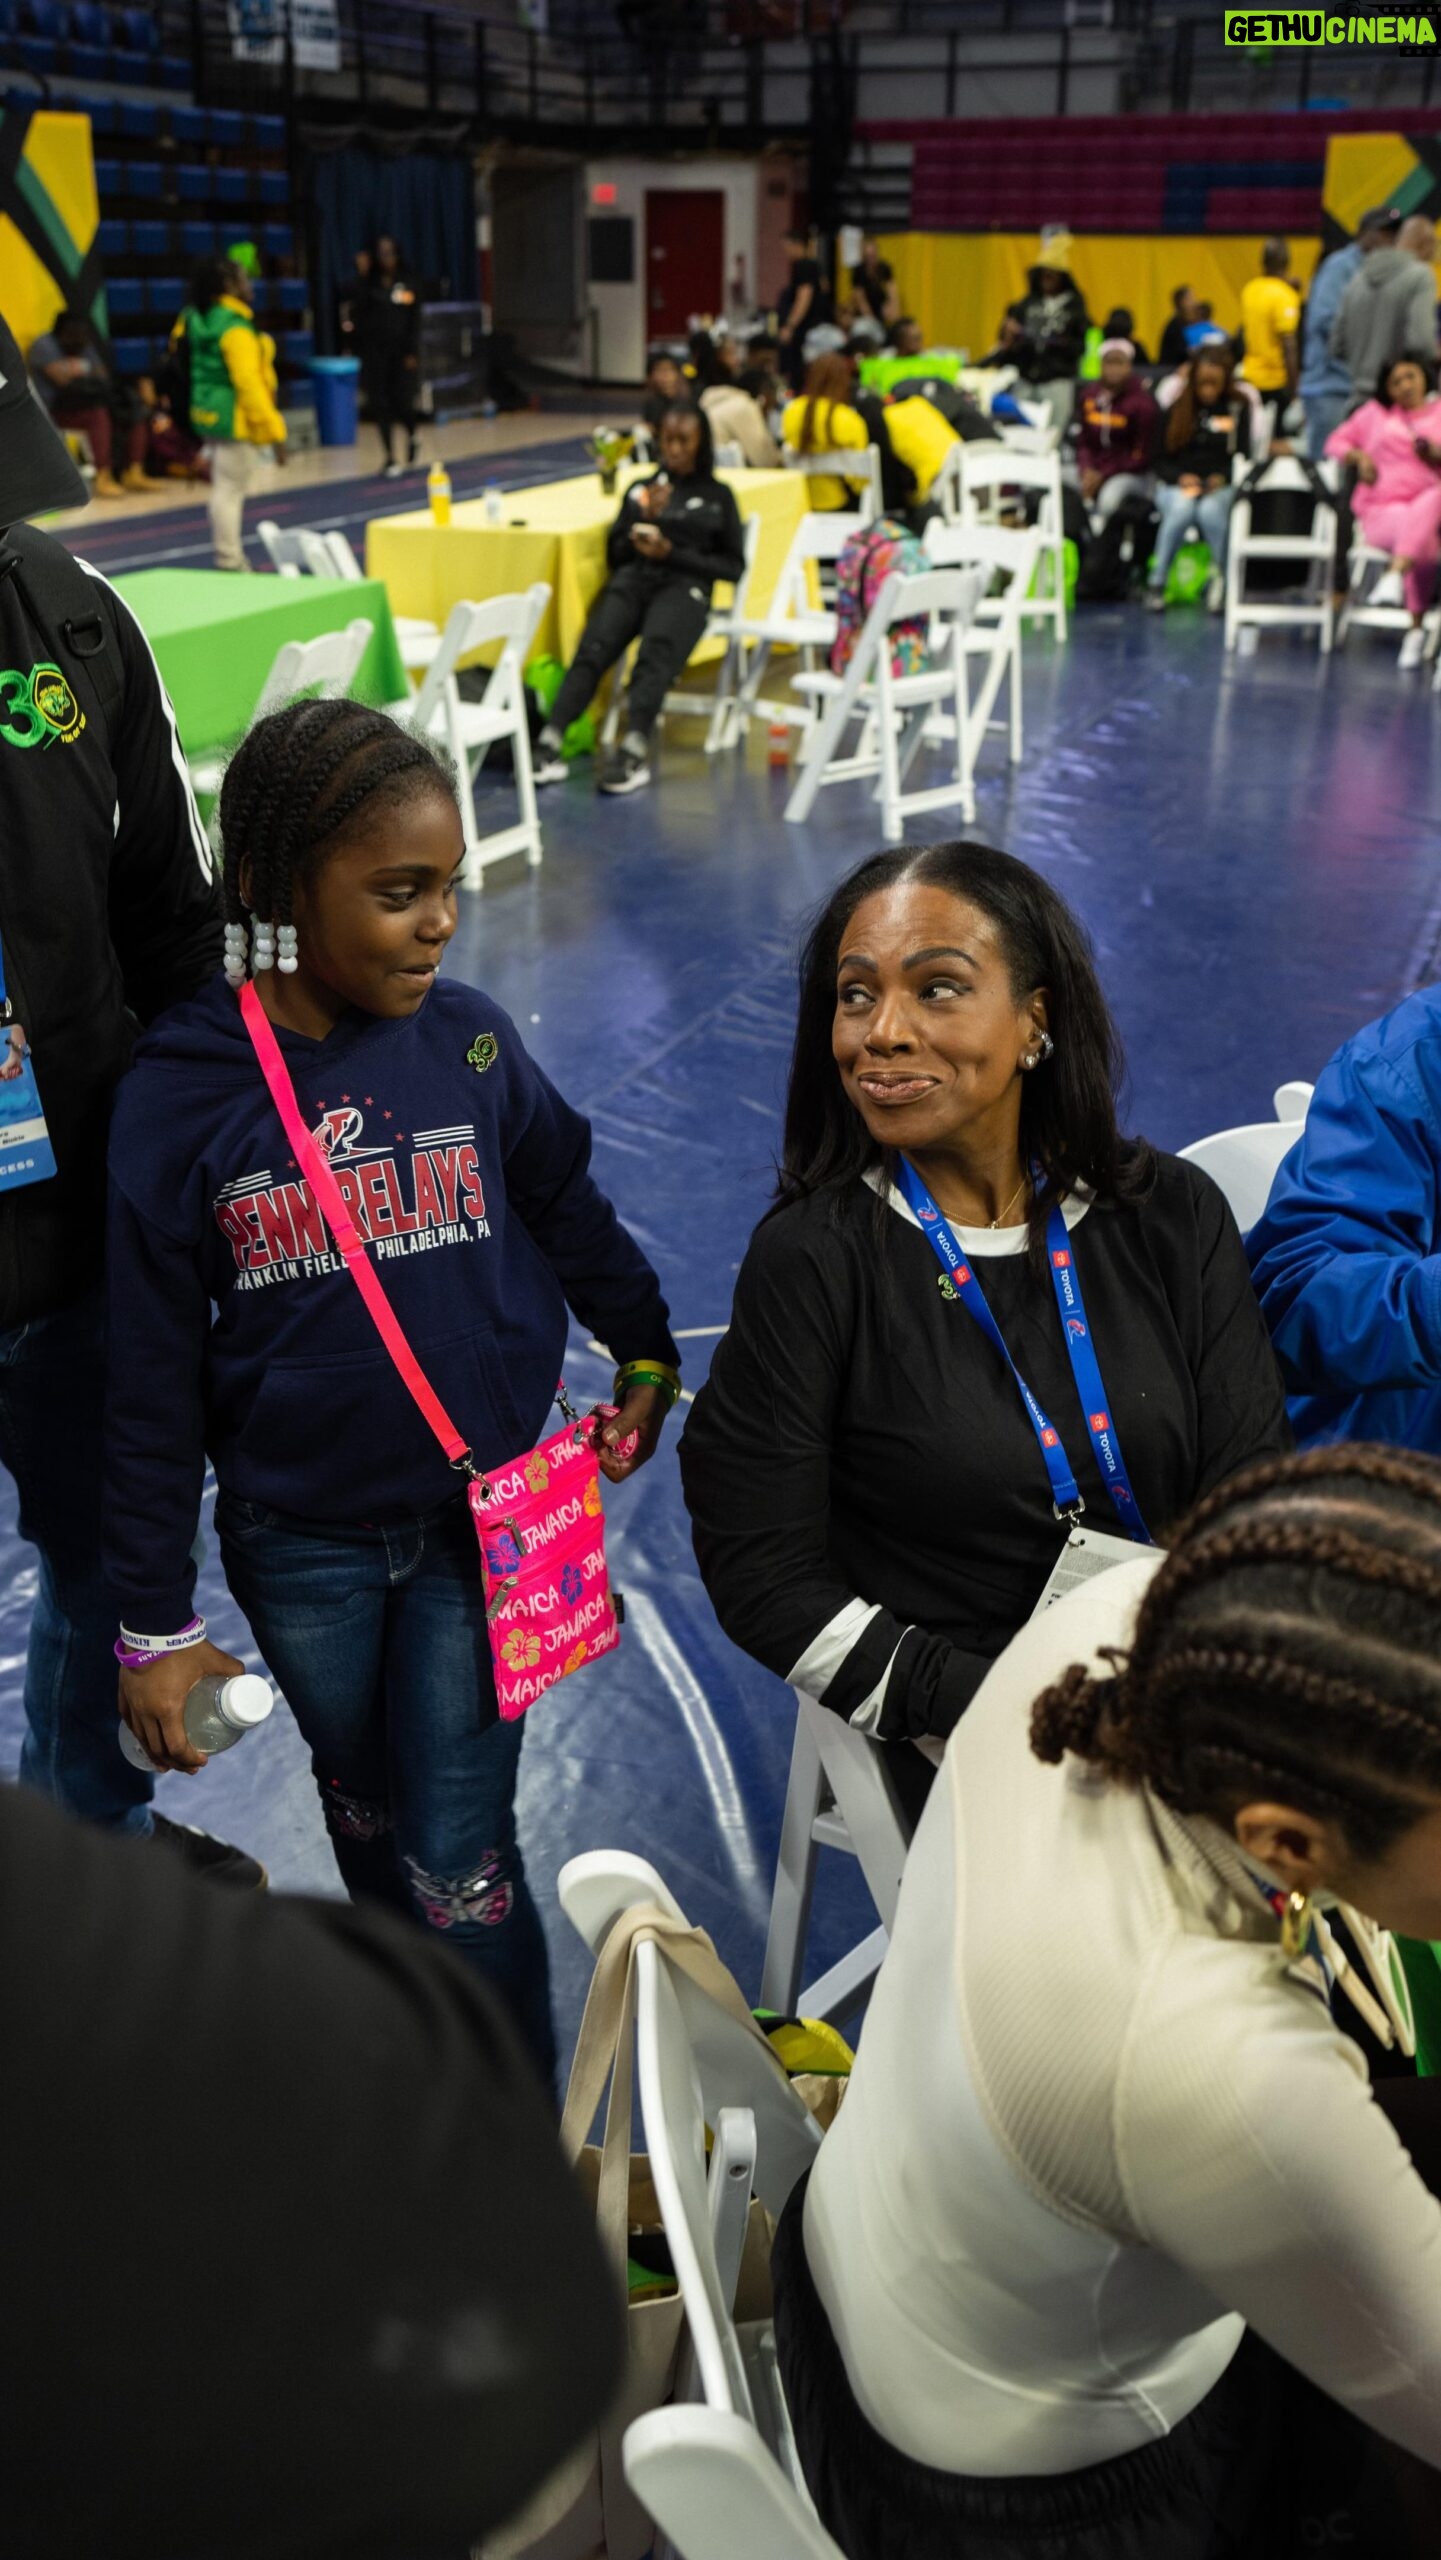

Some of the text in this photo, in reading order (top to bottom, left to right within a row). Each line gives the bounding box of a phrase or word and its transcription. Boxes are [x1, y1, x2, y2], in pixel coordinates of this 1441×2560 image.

[214, 1143, 486, 1271] PENN RELAYS
[375, 1222, 475, 1261] PHILADELPHIA,
[476, 1218, 492, 1240] PA
[936, 1230, 959, 1268] TOYOTA
[1060, 1267, 1075, 1307] TOYOTA
[1099, 1431, 1117, 1473] TOYOTA
[520, 1496, 583, 1554] JAMAICA
[543, 1592, 606, 1652] JAMAICA
